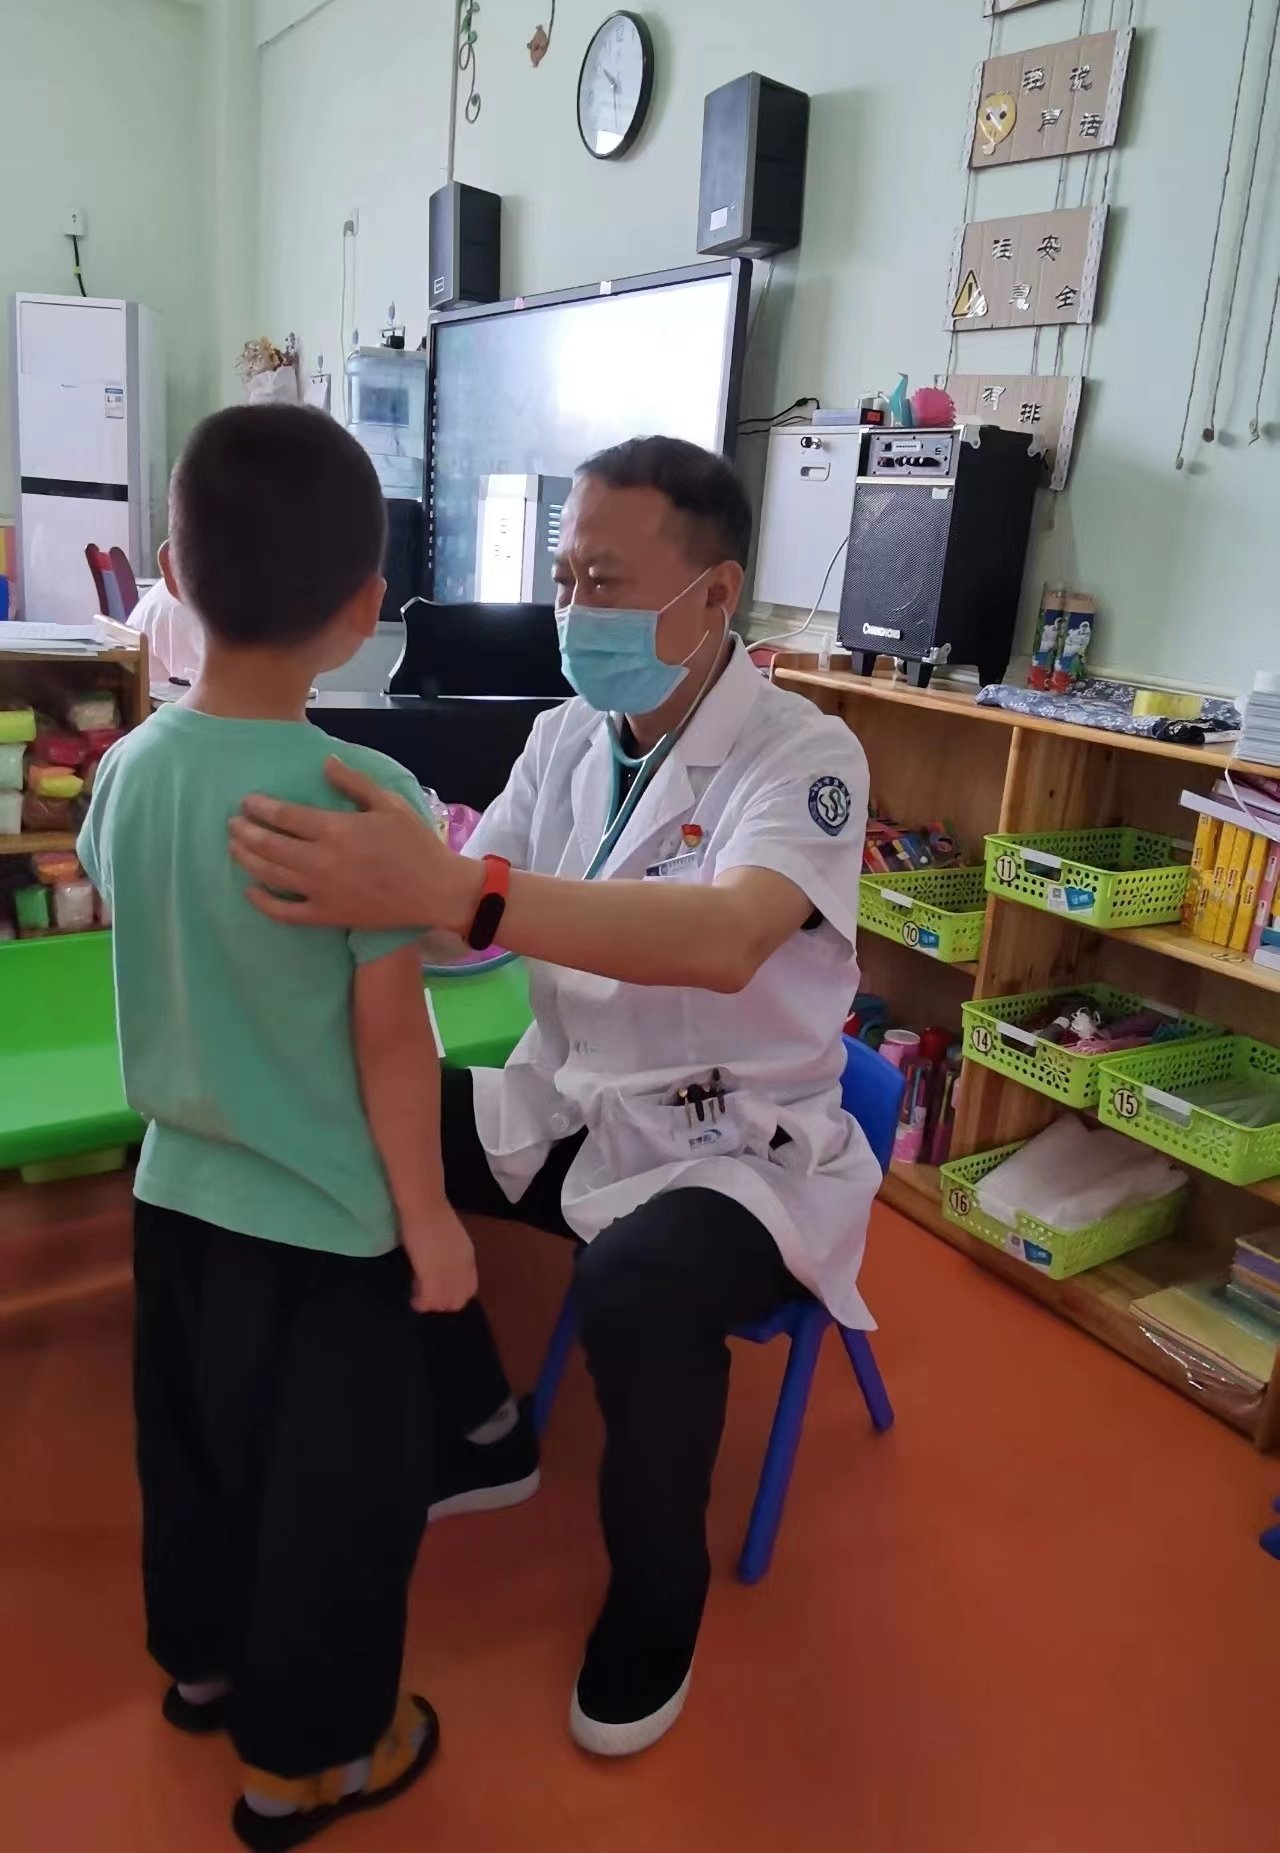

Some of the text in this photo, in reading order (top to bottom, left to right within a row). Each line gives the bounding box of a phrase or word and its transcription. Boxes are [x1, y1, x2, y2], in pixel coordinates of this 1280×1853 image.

[998, 857, 1013, 880] 11
[905, 924, 919, 944] 10
[975, 1028, 989, 1050] 14
[1117, 1091, 1135, 1116] 15
[953, 1191, 970, 1213] 16
